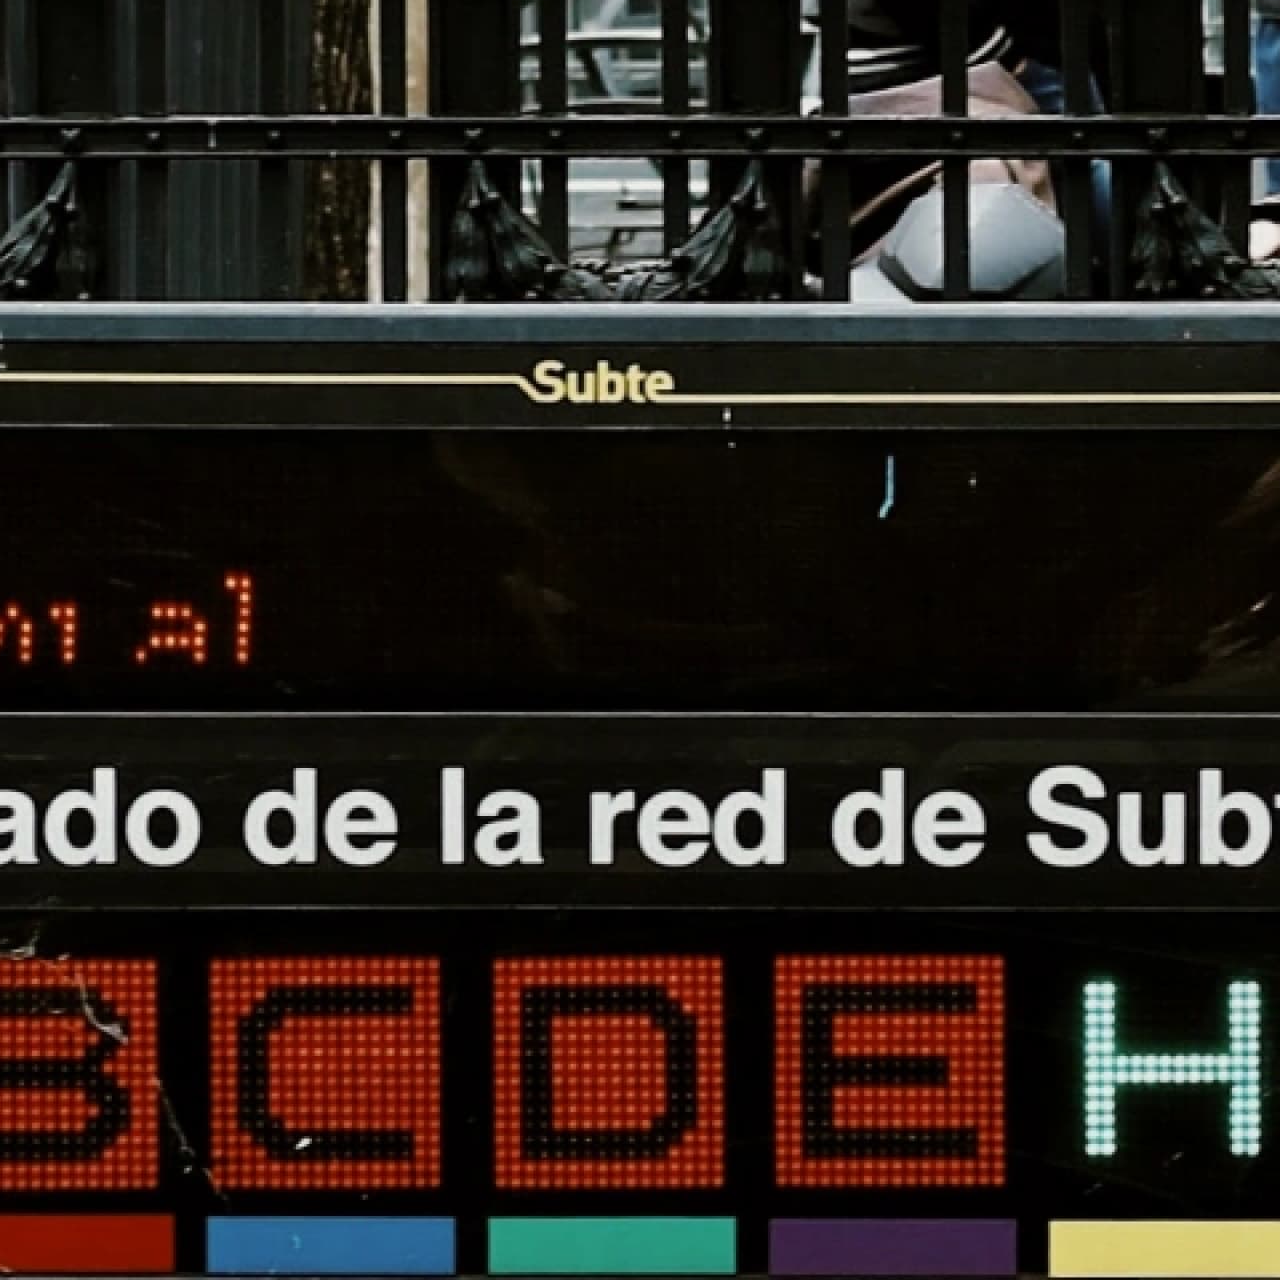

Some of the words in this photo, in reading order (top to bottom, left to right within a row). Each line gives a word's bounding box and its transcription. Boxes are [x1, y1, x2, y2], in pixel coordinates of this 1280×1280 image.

[530, 358, 677, 405] Subte
[243, 766, 399, 867] de
[441, 766, 546, 868] la
[590, 766, 786, 868] red
[830, 766, 986, 868] de
[235, 984, 416, 1163] C
[521, 983, 698, 1163] D
[801, 981, 980, 1159] E
[1082, 979, 1263, 1157] H
